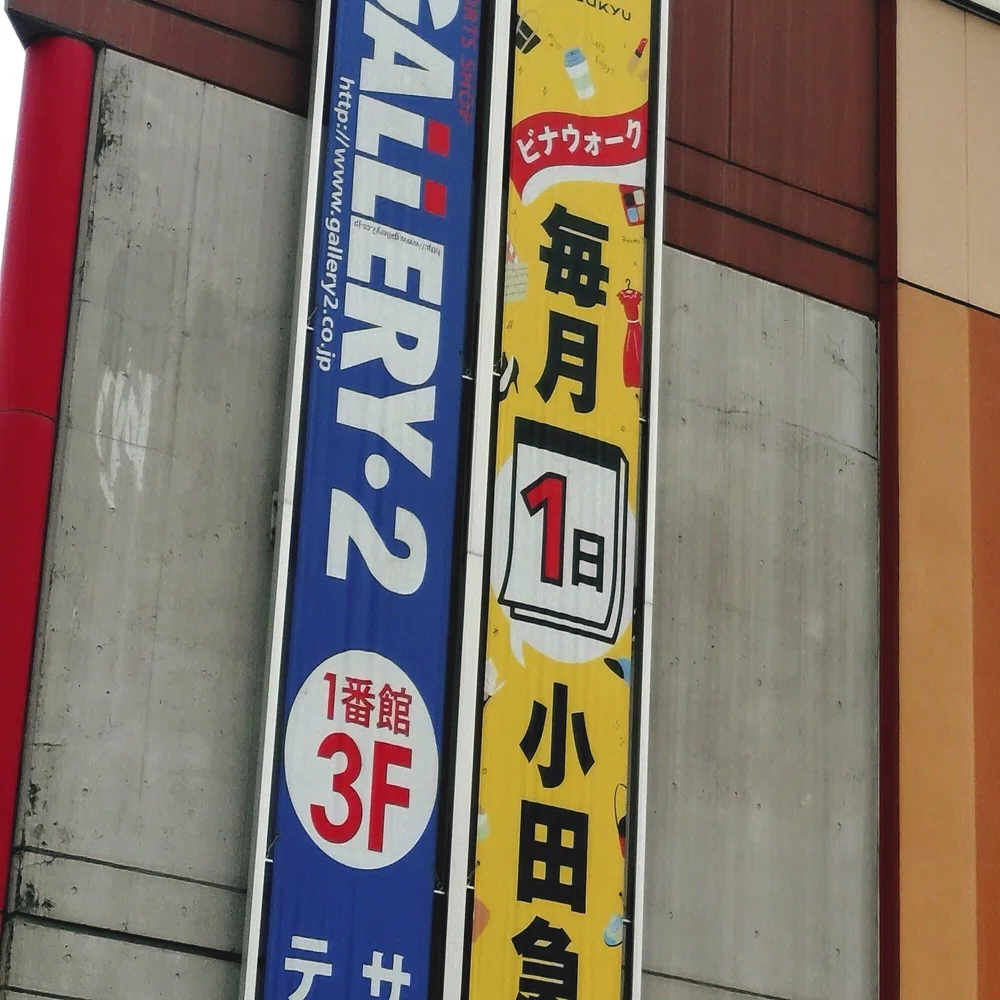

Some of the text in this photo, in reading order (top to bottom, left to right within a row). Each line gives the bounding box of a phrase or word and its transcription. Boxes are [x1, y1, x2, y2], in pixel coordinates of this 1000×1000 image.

[457, 54, 476, 124] SHOP
[516, 119, 641, 164] ビナウォーク
[316, 75, 355, 371] http://www.gallery2.co.jp
[534, 203, 610, 414] 毎月
[520, 471, 605, 593] 1日
[323, 672, 412, 737] 1番館
[310, 732, 412, 853] 3F
